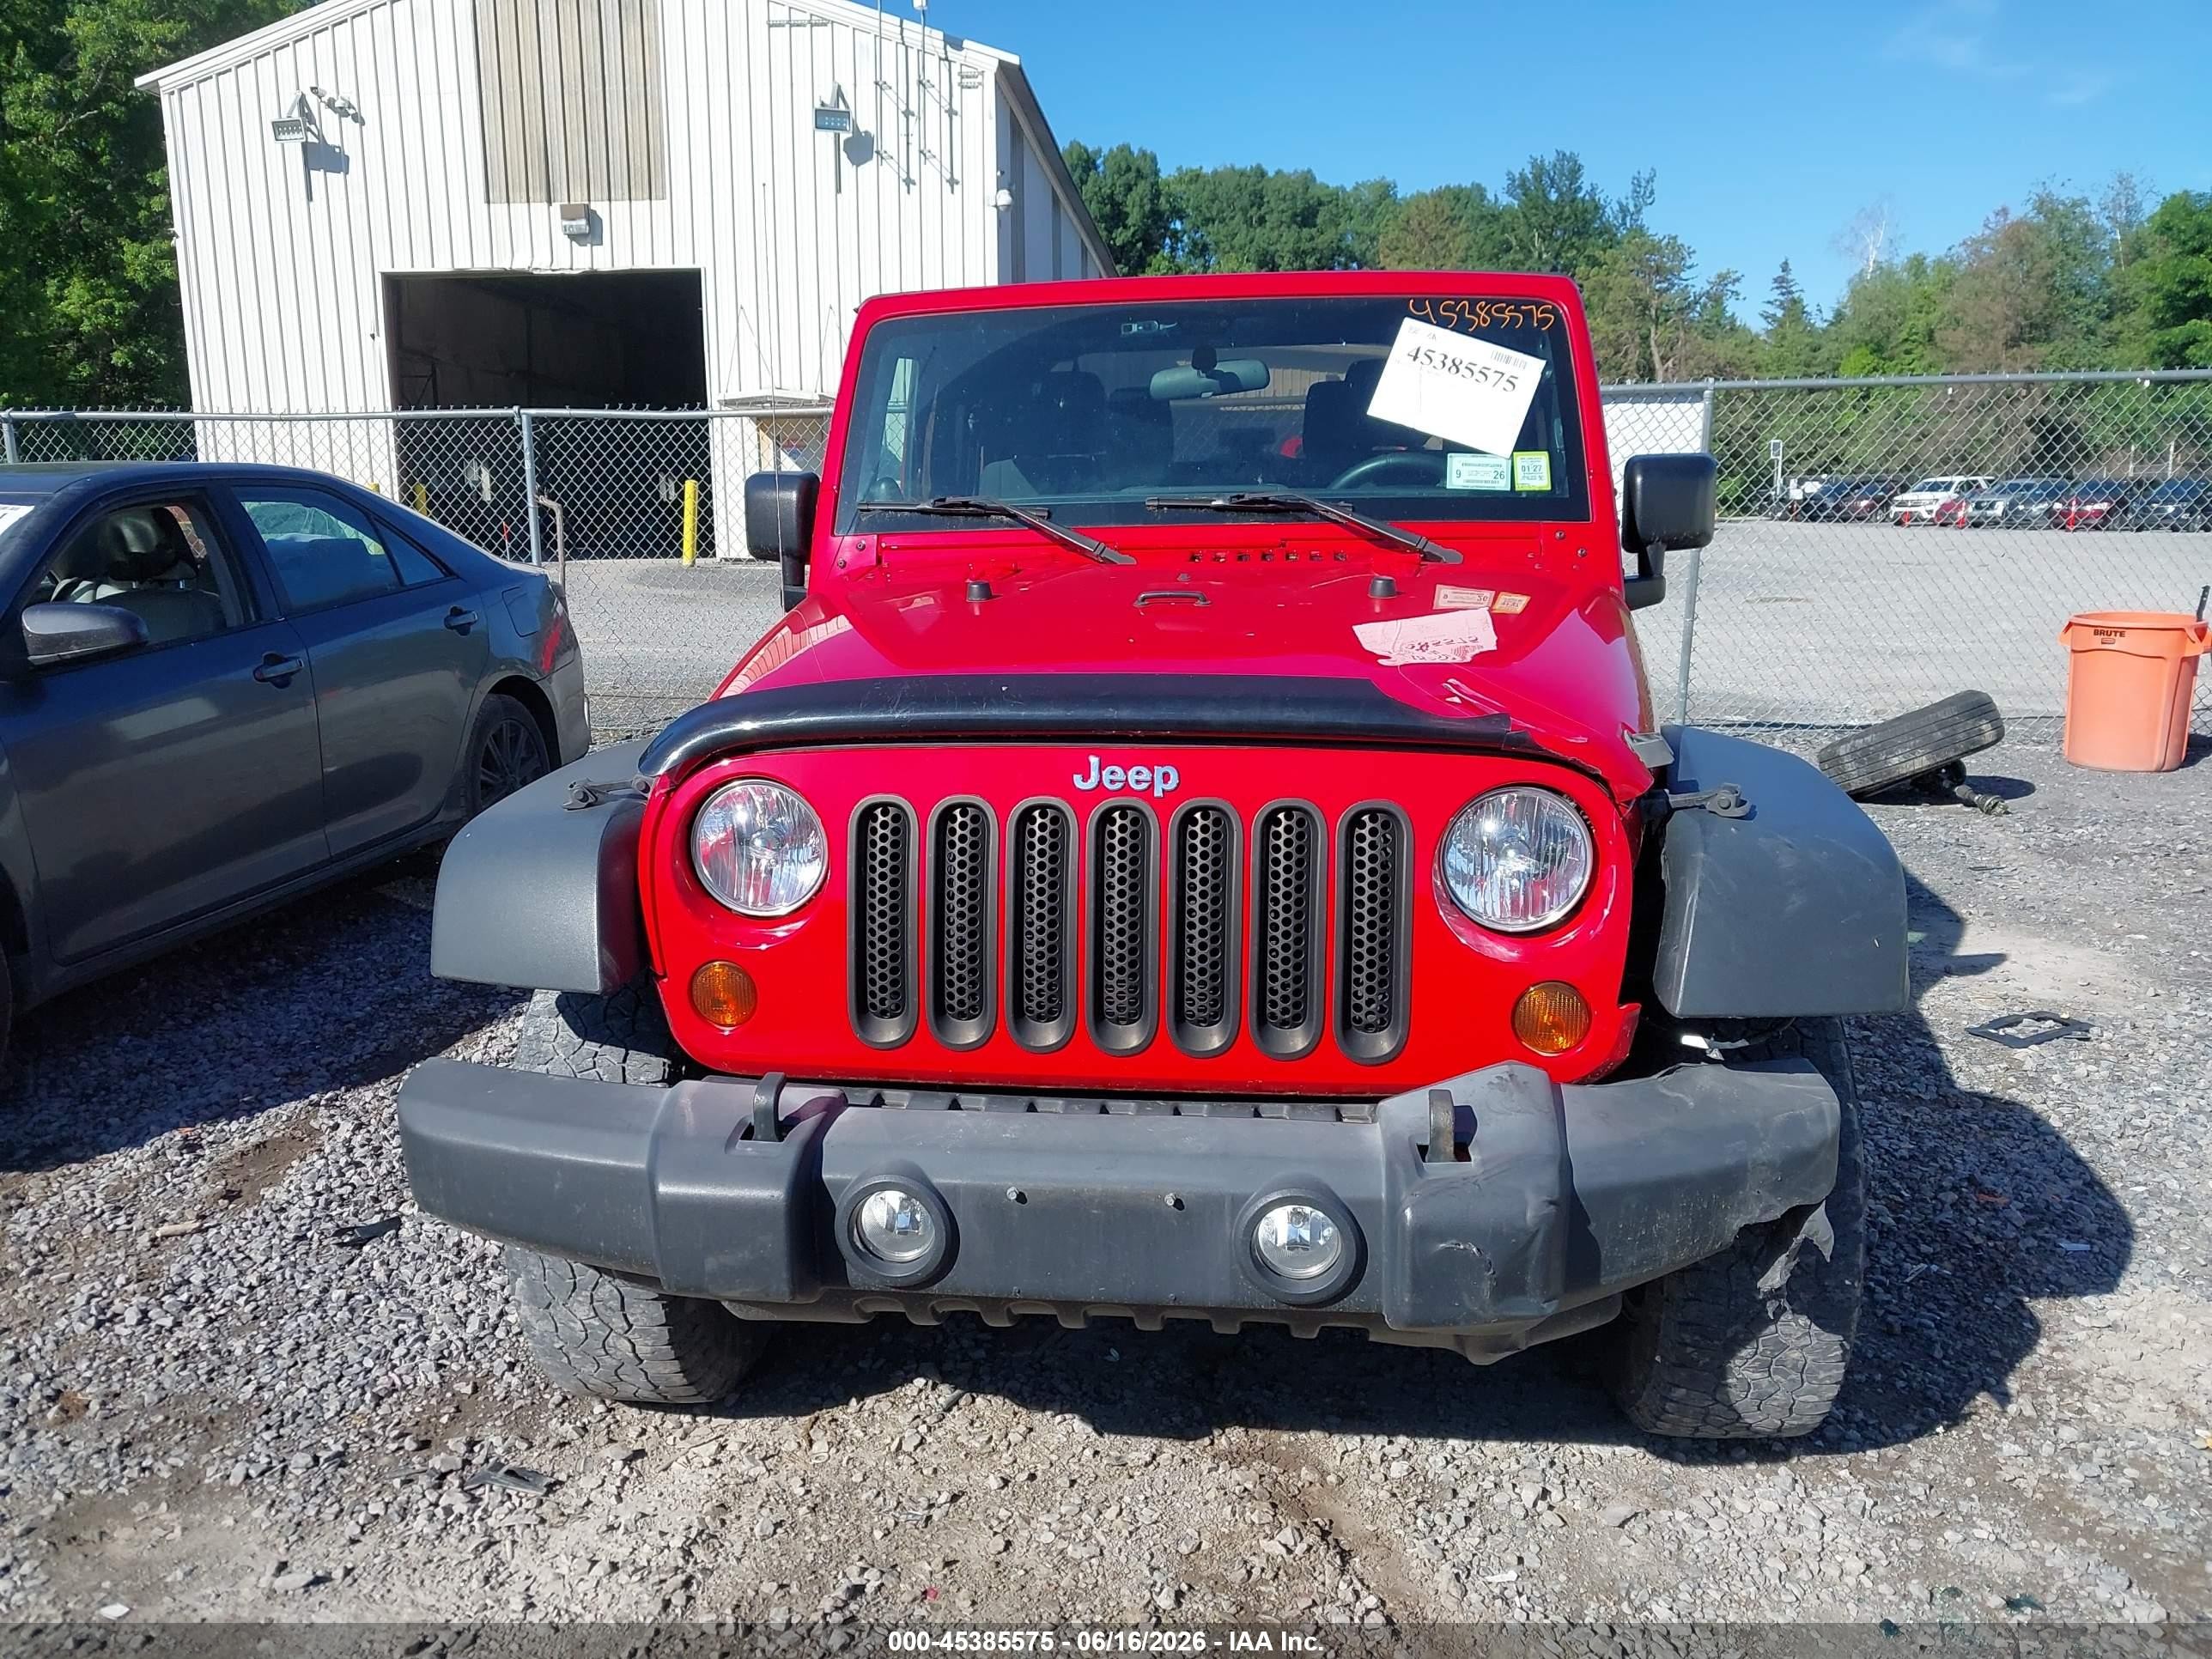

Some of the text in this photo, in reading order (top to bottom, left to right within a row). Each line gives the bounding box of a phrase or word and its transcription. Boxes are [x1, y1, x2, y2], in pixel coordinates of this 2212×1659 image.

[1408, 299, 1556, 332] 45385575
[1407, 345, 1519, 392] 45385575
[1455, 469, 1462, 478] 9
[1492, 470, 1505, 480] 26
[2094, 629, 2126, 638] BRUTE
[1073, 754, 1180, 798] Jeep
